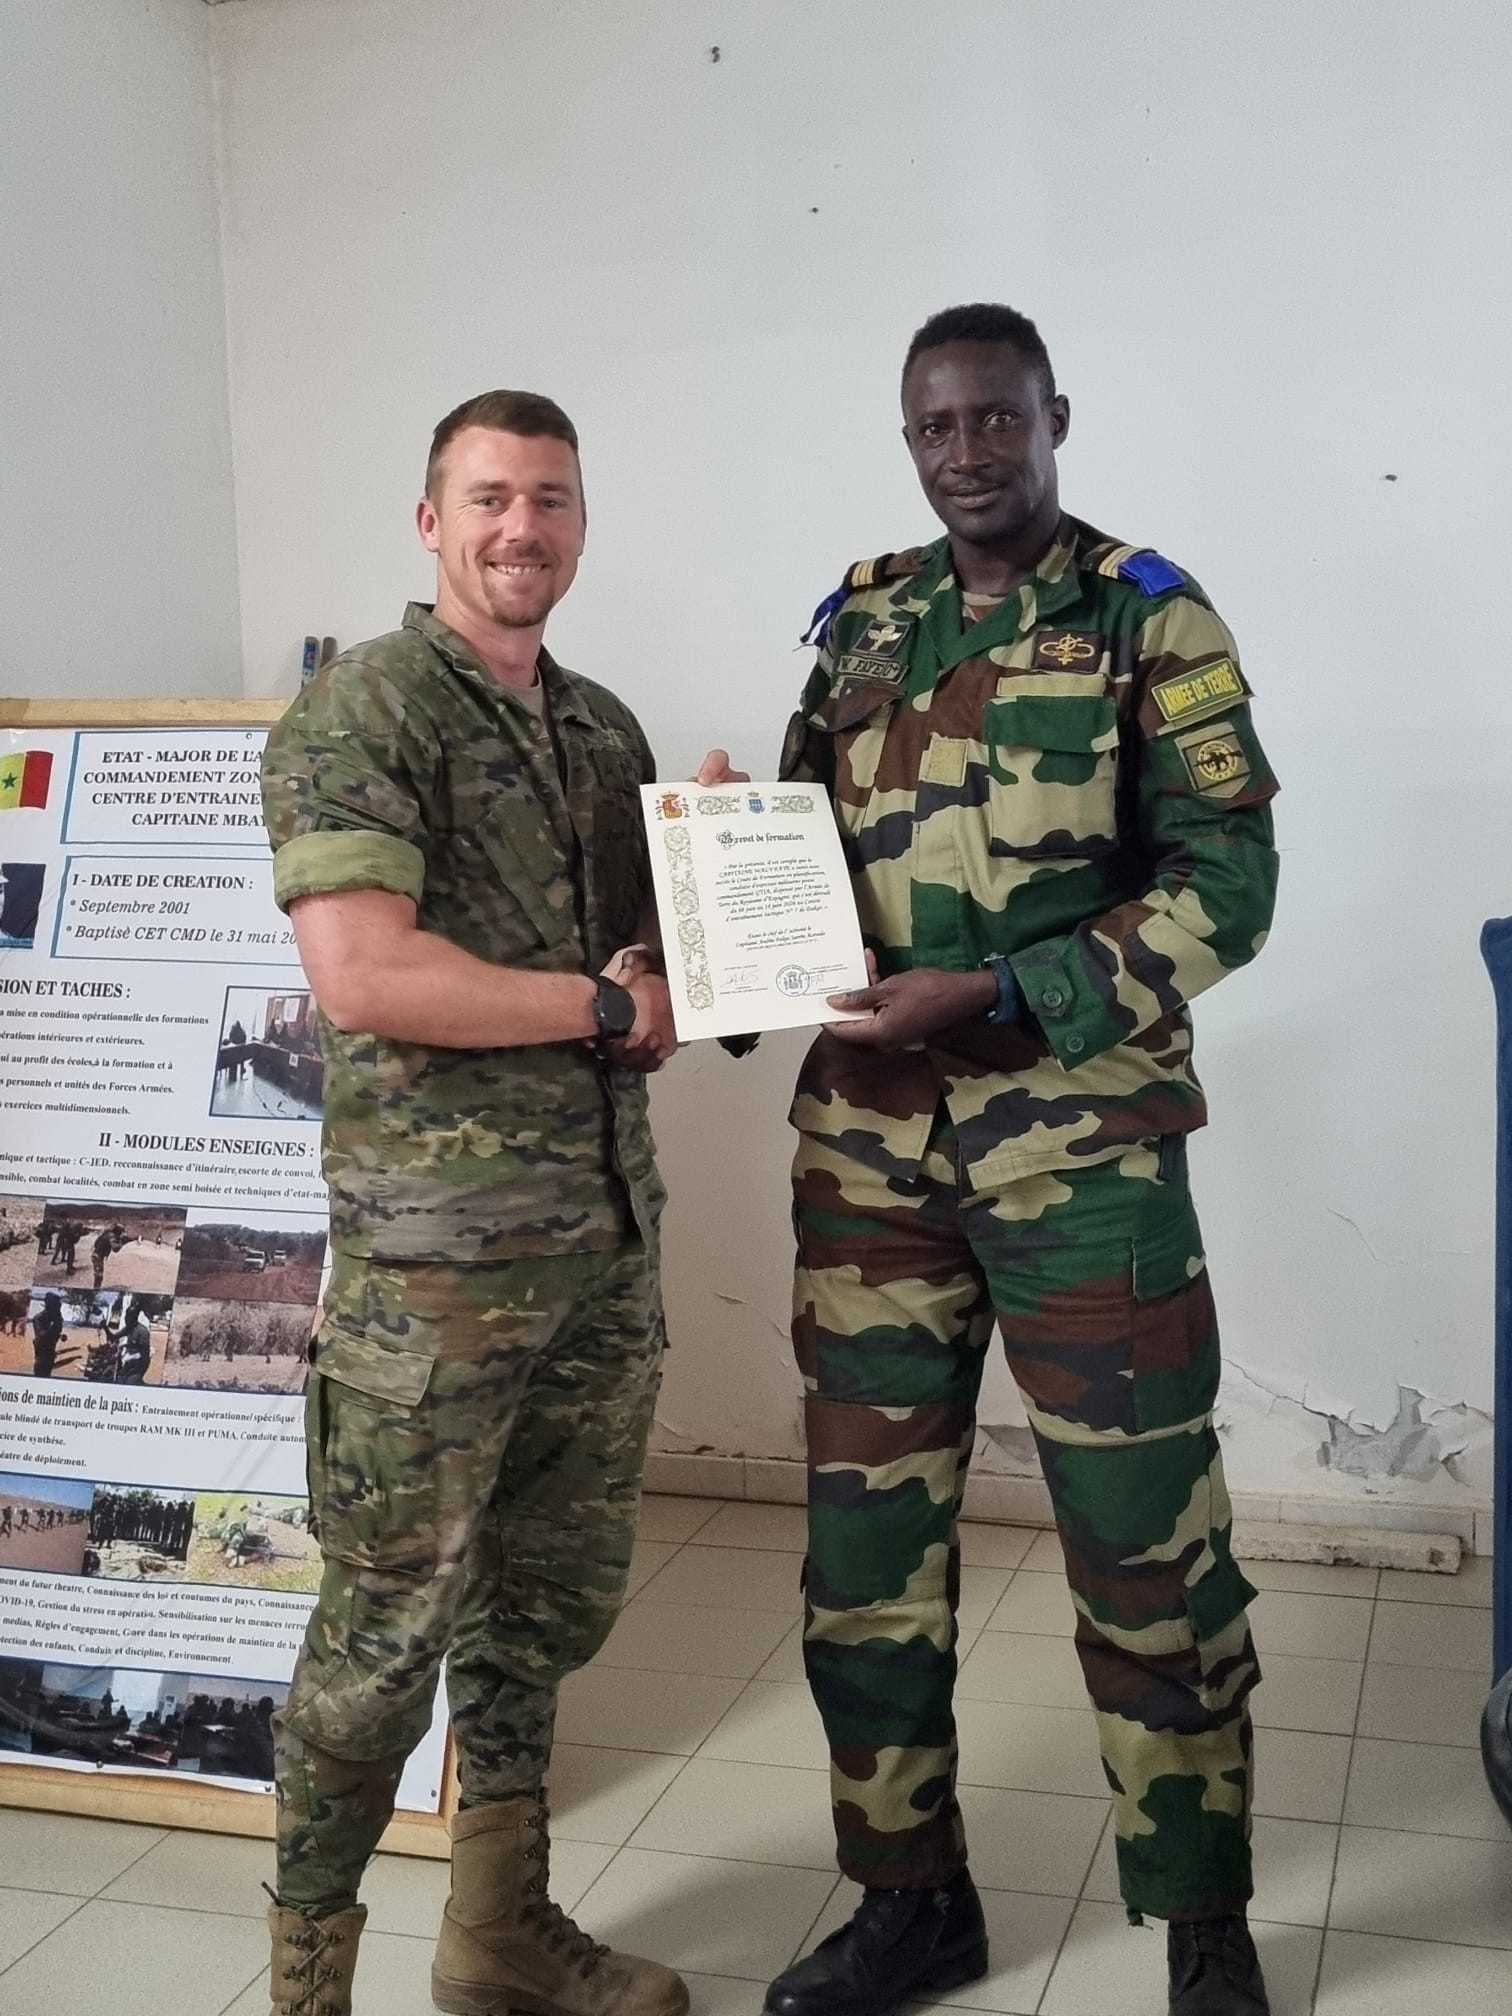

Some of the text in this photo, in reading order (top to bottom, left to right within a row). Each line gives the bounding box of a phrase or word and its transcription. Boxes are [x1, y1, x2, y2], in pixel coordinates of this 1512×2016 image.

[1190, 678, 1210, 701] DE
[1202, 662, 1238, 696] TERRE
[102, 752, 144, 763] ETAT
[155, 750, 212, 762] MAJOR
[216, 750, 238, 762] DE
[83, 771, 226, 784] COMMANDEMENT
[92, 792, 157, 804] CENTRE
[132, 814, 219, 826] CAPITAINE
[756, 833, 764, 842] de
[766, 832, 805, 844] formation
[72, 874, 246, 889] I DATE DE CREATION
[79, 900, 190, 915] Septembre 2001
[134, 927, 167, 941] CET
[170, 928, 206, 942] CMD
[210, 929, 223, 942] le
[226, 930, 244, 943] 31
[247, 930, 276, 944] mai
[36, 980, 58, 996] ET
[61, 981, 124, 999] TACHES
[6, 1008, 209, 1024] mise en condition opérationnelle des formations
[38, 1032, 83, 1043] intérieures
[86, 1036, 94, 1044] et
[96, 1034, 145, 1046] extérieures.
[24, 1055, 48, 1066] profit
[50, 1056, 64, 1066] des
[102, 1058, 110, 1067] la
[112, 1058, 155, 1069] formation
[157, 1062, 166, 1070] et
[6, 1078, 174, 1094] personnels et unités des Forces Armées.
[4, 1101, 132, 1115] exercices multidimensionnels.
[98, 1132, 306, 1158] II MODULES ENSEIGNES
[26, 1155, 34, 1163] et
[36, 1155, 70, 1167] tactique
[272, 1168, 282, 1177] de
[28, 1175, 60, 1185] combat
[63, 1176, 100, 1188] localités,
[102, 1179, 135, 1189] combat
[138, 1182, 148, 1190] en
[150, 1183, 170, 1191] zone
[172, 1182, 192, 1192] semi
[195, 1184, 221, 1194] boisée
[224, 1186, 232, 1194] et
[234, 1185, 281, 1198] techniques
[22, 1389, 34, 1404] de
[36, 1392, 81, 1408] maintien
[84, 1394, 97, 1410] de
[98, 1396, 108, 1411] la
[110, 1398, 133, 1415] paix
[142, 1405, 199, 1418] Entrainement
[254, 1412, 296, 1424] spécifique
[14, 1413, 40, 1424] blindé
[42, 1414, 52, 1424] de
[54, 1416, 92, 1430] transport
[95, 1420, 105, 1430] de
[107, 1422, 138, 1434] troupes
[140, 1424, 163, 1434] RAM
[165, 1427, 181, 1436] MK
[184, 1428, 196, 1437] III
[198, 1430, 206, 1438] et
[208, 1430, 239, 1440] PUMA.
[17, 1432, 27, 1442] de
[22, 1452, 33, 1462] de
[34, 1454, 87, 1467] déploiement.
[19, 1578, 30, 1588] du
[32, 1580, 52, 1590] futur
[86, 1586, 140, 1599] Connaissance
[142, 1590, 155, 1600] des
[170, 1592, 179, 1600] et
[180, 1593, 220, 1603] coutumes
[222, 1595, 233, 1604] du
[234, 1598, 256, 1609] pays,
[38, 1600, 68, 1612] Gestion
[70, 1602, 80, 1612] du
[82, 1605, 104, 1615] stress
[106, 1608, 116, 1616] en
[158, 1609, 217, 1622] Sensibilisation
[220, 1616, 233, 1624] sur
[235, 1616, 246, 1625] les
[248, 1619, 282, 1629] menaces
[62, 1622, 120, 1637] d'engagement,
[148, 1628, 167, 1639] dans
[170, 1630, 180, 1640] les
[182, 1632, 224, 1643] opérations
[226, 1634, 237, 1644] de
[238, 1636, 275, 1648] maintien
[276, 1639, 289, 1649] de
[289, 1641, 297, 1650] la
[30, 1638, 43, 1648] des
[44, 1640, 76, 1652] enfants,
[114, 1647, 123, 1656] et
[125, 1646, 166, 1659] discipline,
[168, 1650, 232, 1664] Environnement
